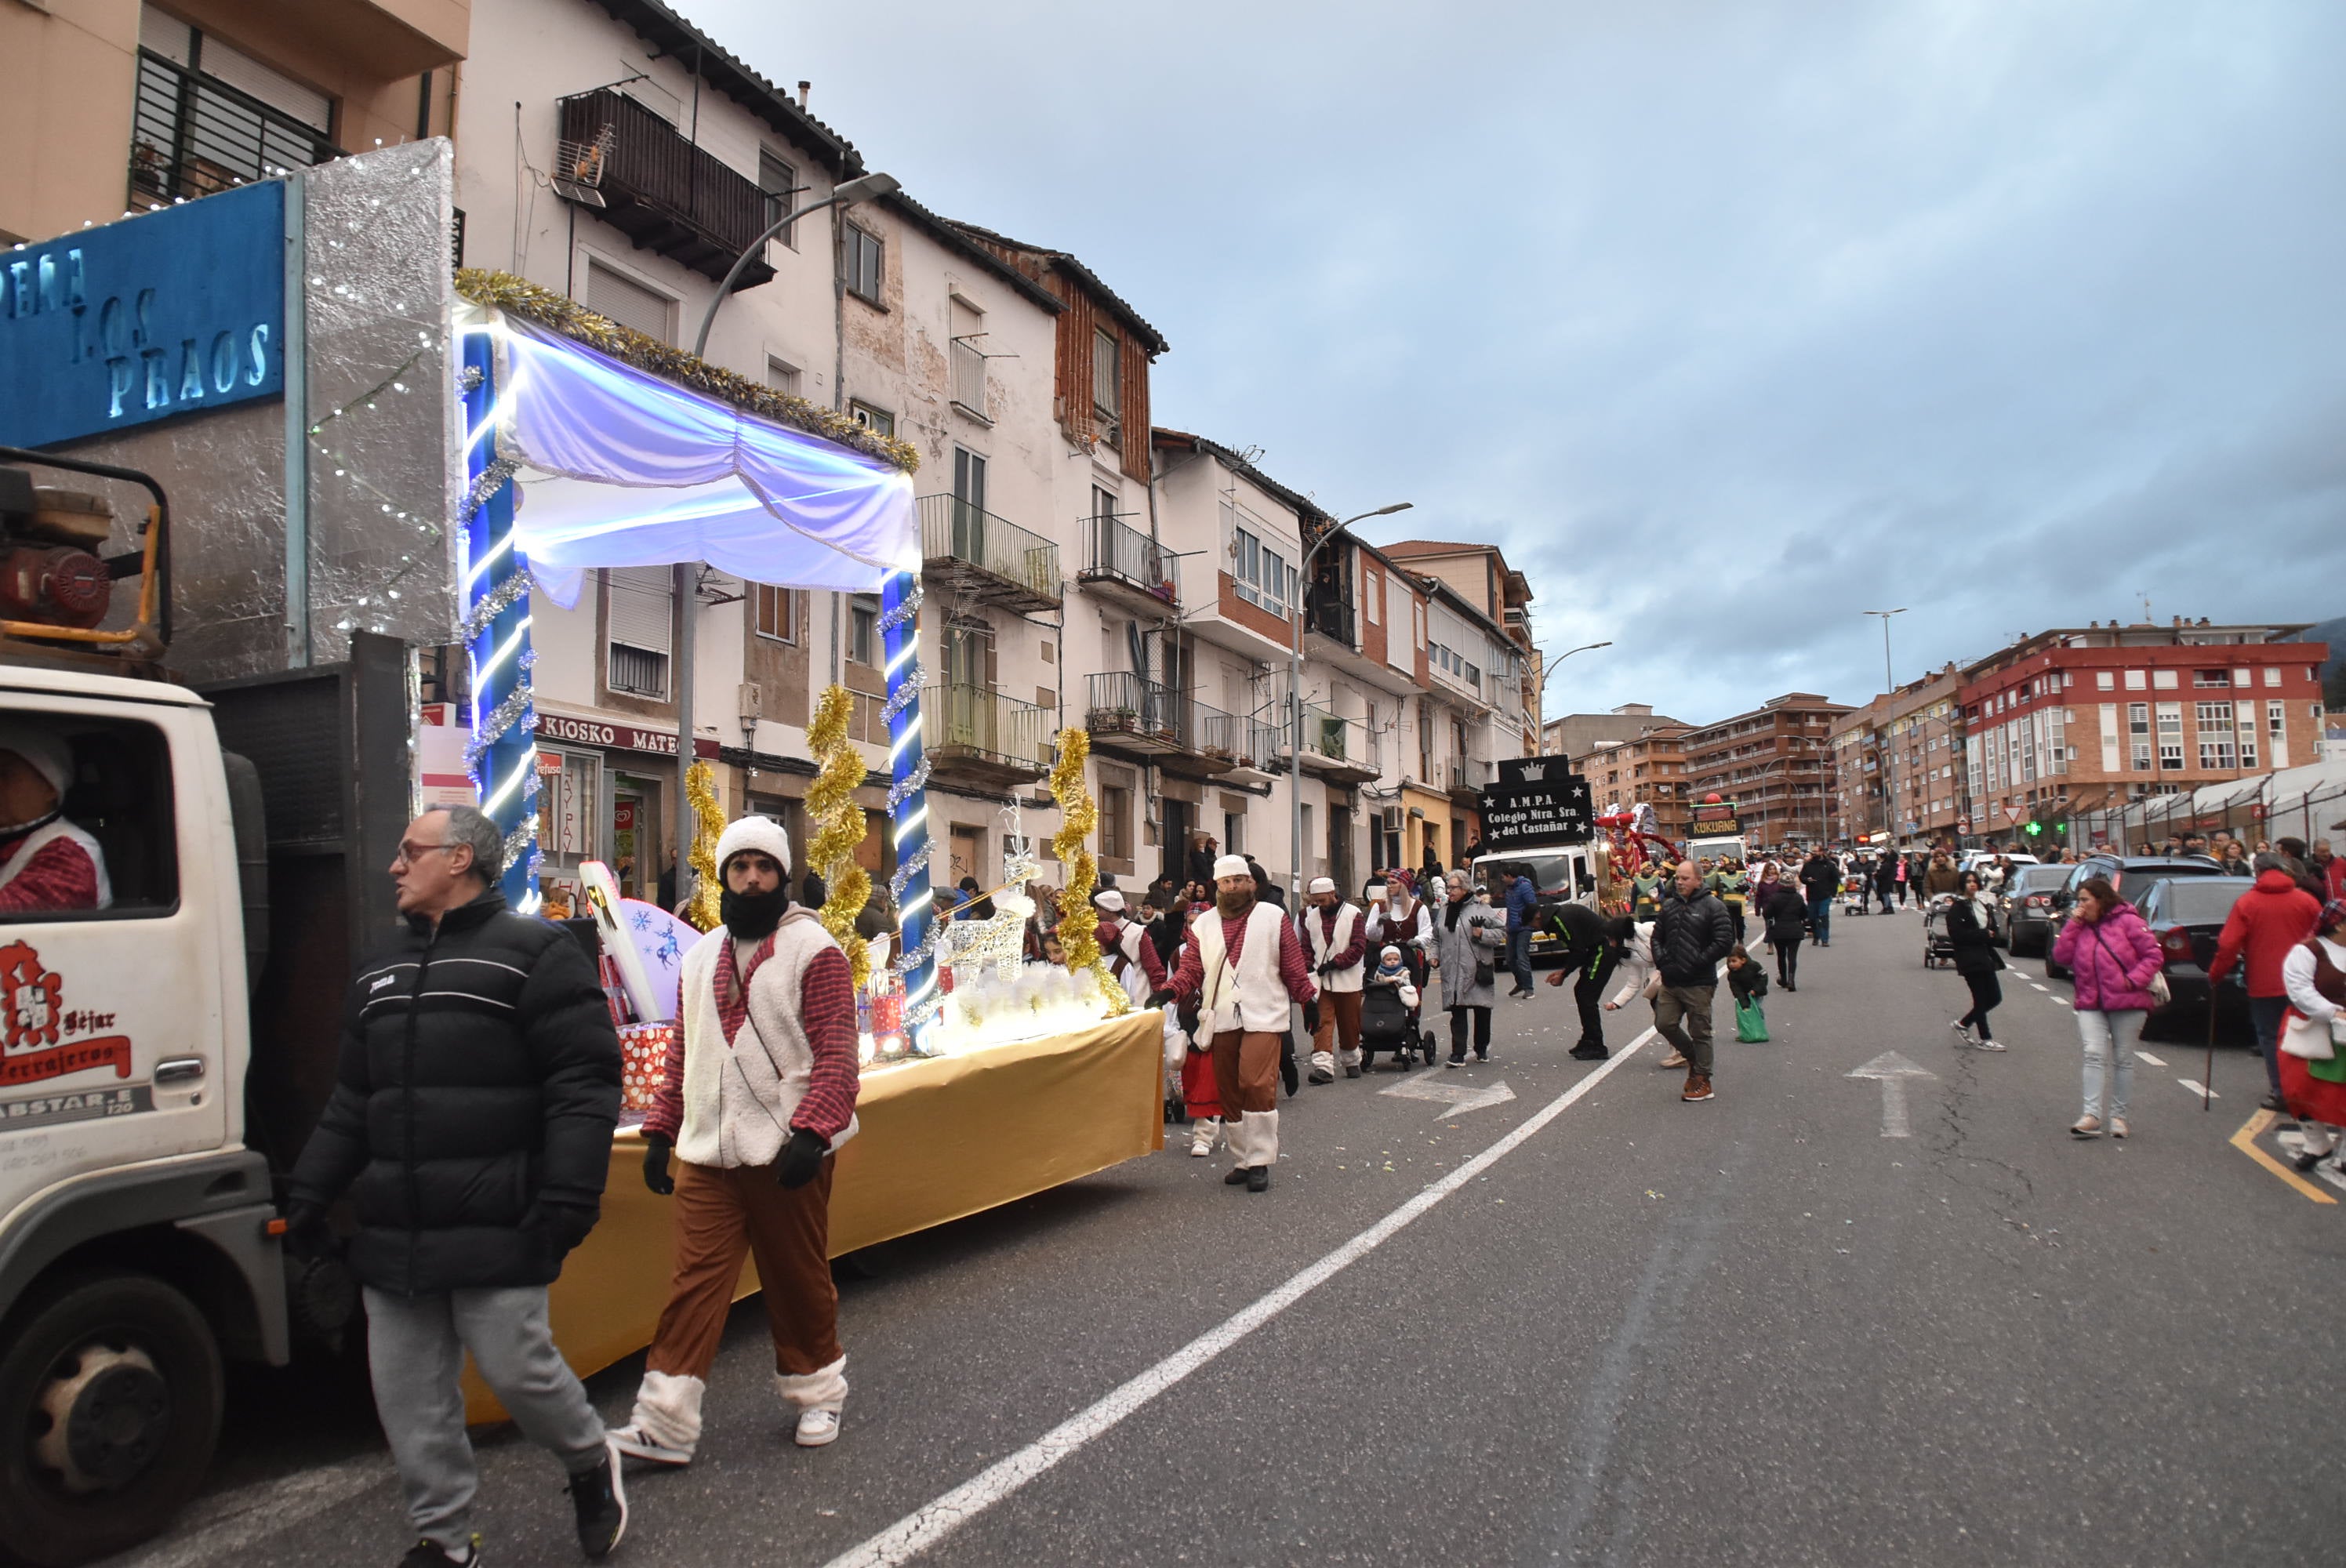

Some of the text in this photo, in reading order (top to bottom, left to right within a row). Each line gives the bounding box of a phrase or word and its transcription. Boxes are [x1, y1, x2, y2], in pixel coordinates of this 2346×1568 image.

[71, 287, 156, 365] LOS
[105, 321, 268, 418] PRAOS
[545, 717, 697, 757] KIOSKO MATES
[534, 763, 561, 775] refusa
[1509, 794, 1556, 808] A.M.P.A.
[1488, 807, 1580, 824] Colegio Ntra. Sra.
[1502, 821, 1568, 836] del Castañar
[1694, 819, 1737, 834] KUKUANA
[107, 1102, 134, 1115] 120
